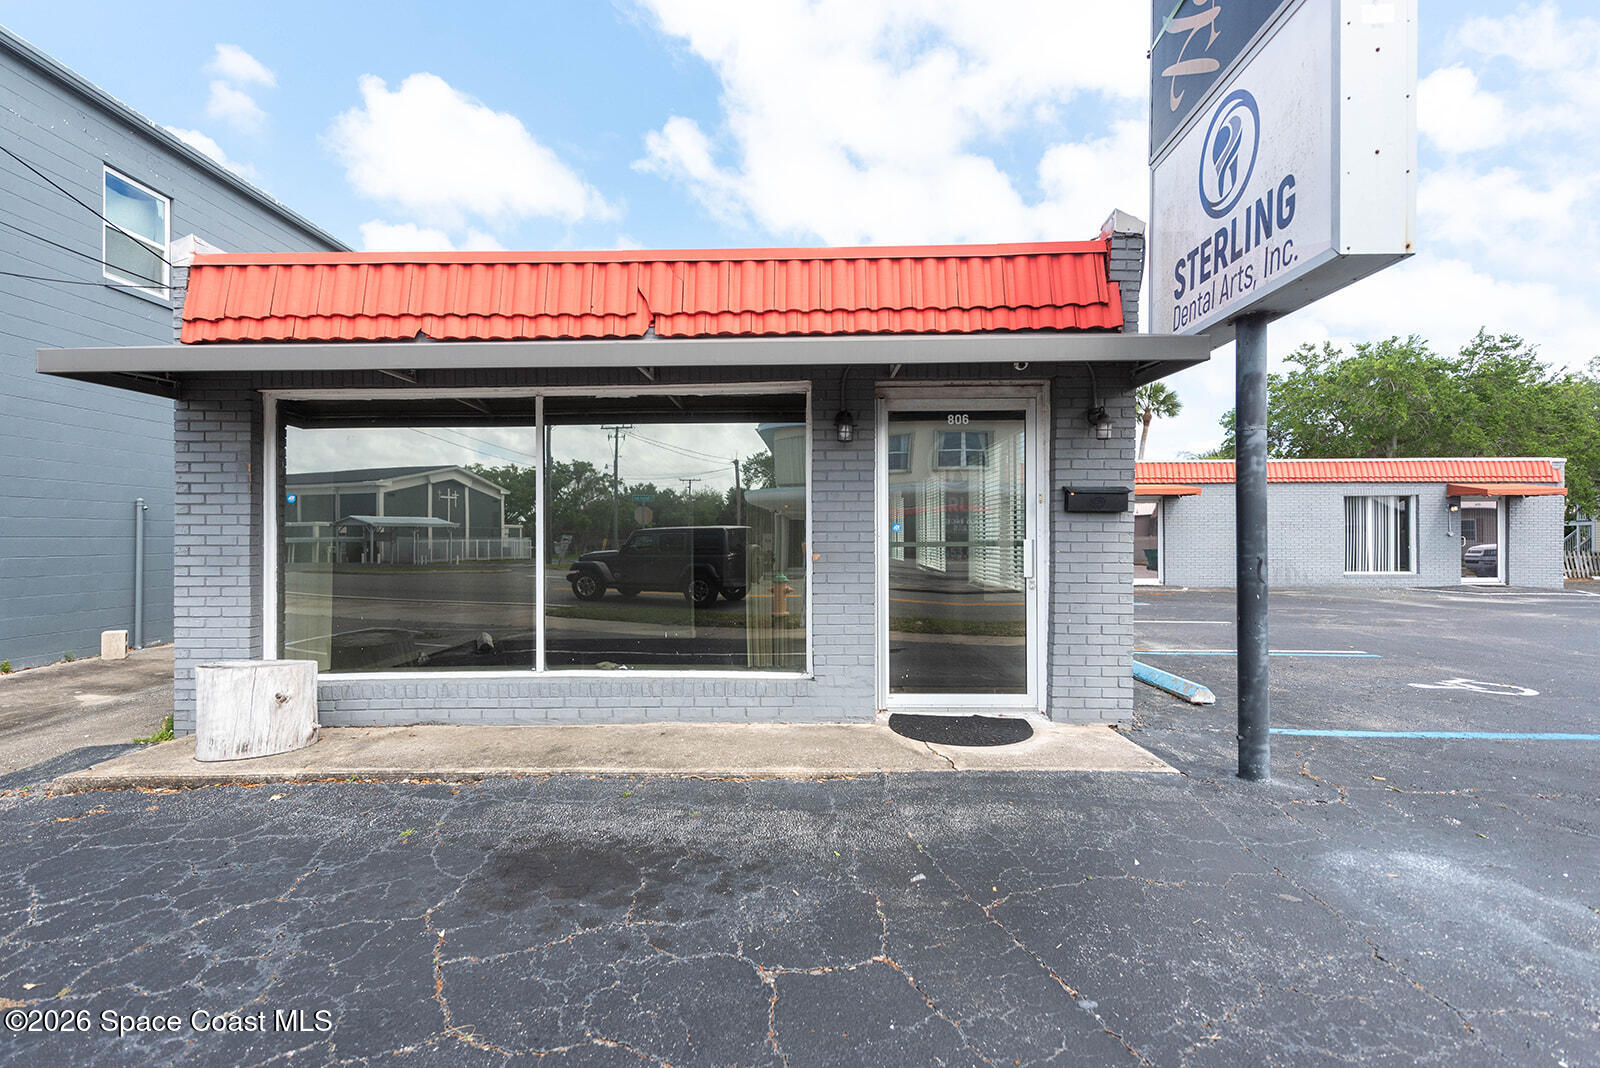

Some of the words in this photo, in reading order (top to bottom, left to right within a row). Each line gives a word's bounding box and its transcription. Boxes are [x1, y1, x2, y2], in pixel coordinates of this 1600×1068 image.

[1174, 174, 1296, 300] STERLING
[1173, 287, 1215, 332] Dental
[1219, 264, 1257, 304] Arts,
[1264, 239, 1298, 278] Inc.
[947, 414, 969, 425] 806
